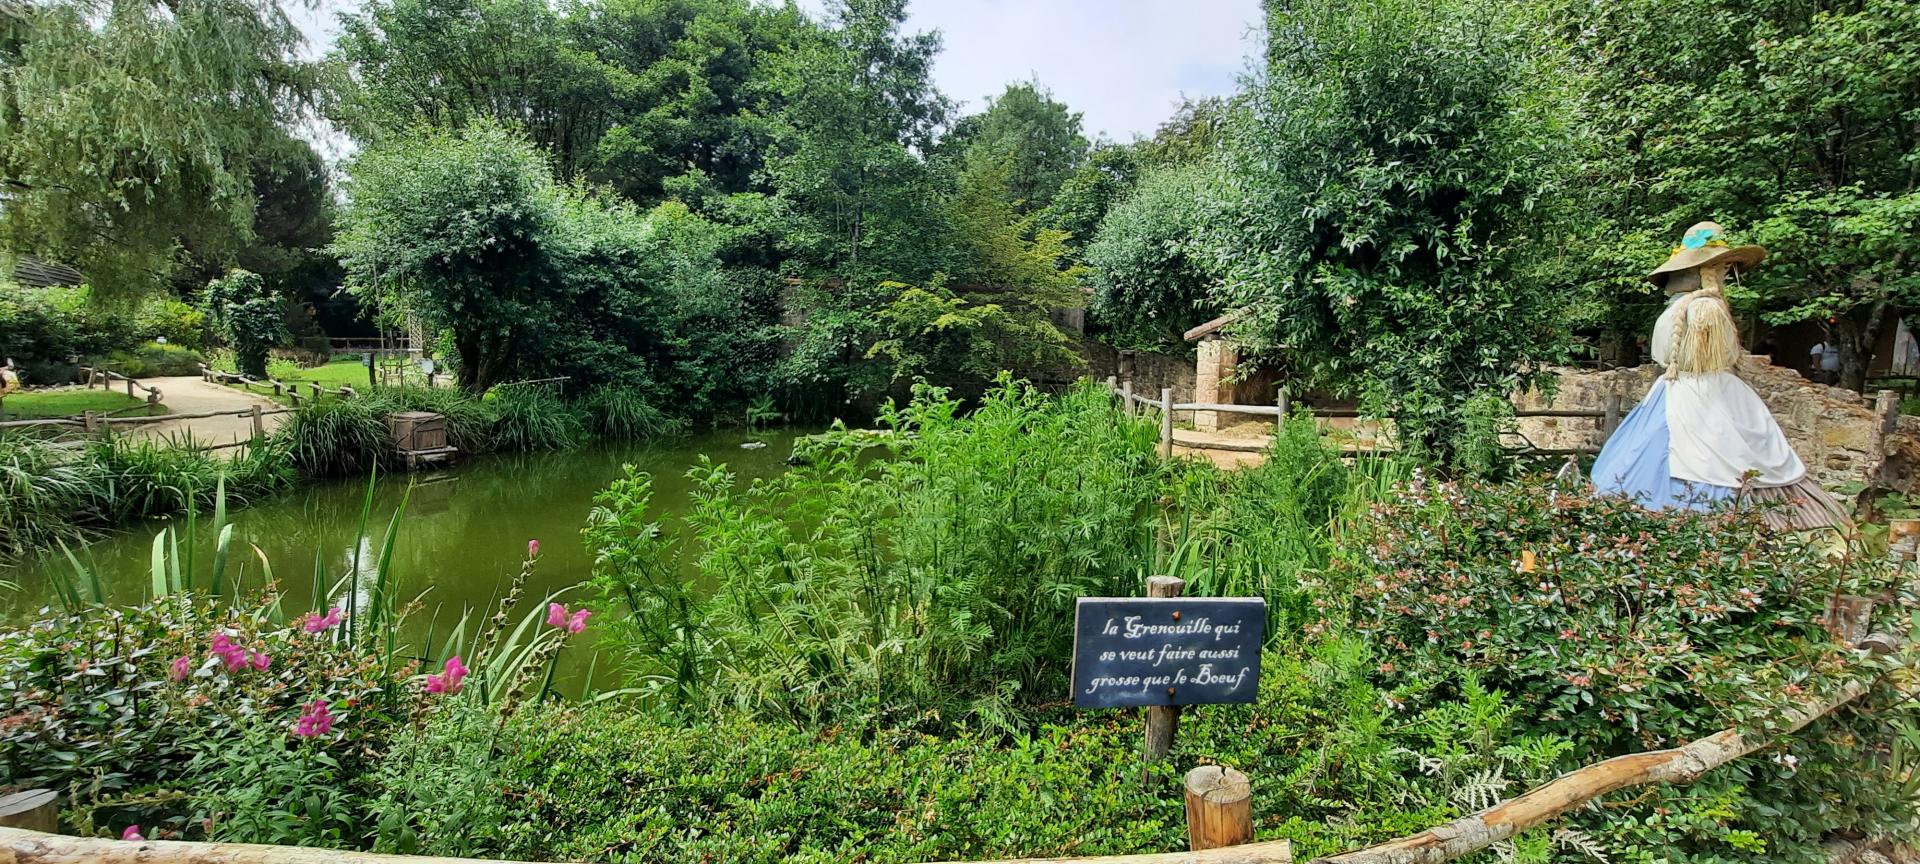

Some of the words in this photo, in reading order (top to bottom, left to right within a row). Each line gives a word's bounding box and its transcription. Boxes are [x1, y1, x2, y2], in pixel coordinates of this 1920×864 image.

[1102, 618, 1118, 635] la
[1123, 616, 1211, 639] Grenouille
[1214, 620, 1241, 640] qui
[1099, 650, 1116, 661] se
[1119, 648, 1155, 661] veut
[1153, 644, 1195, 667] faire
[1199, 645, 1240, 659] aussi
[1085, 674, 1139, 694] grosse
[1143, 675, 1170, 693] que
[1172, 668, 1187, 685] le
[1190, 663, 1250, 691] Boeuf
